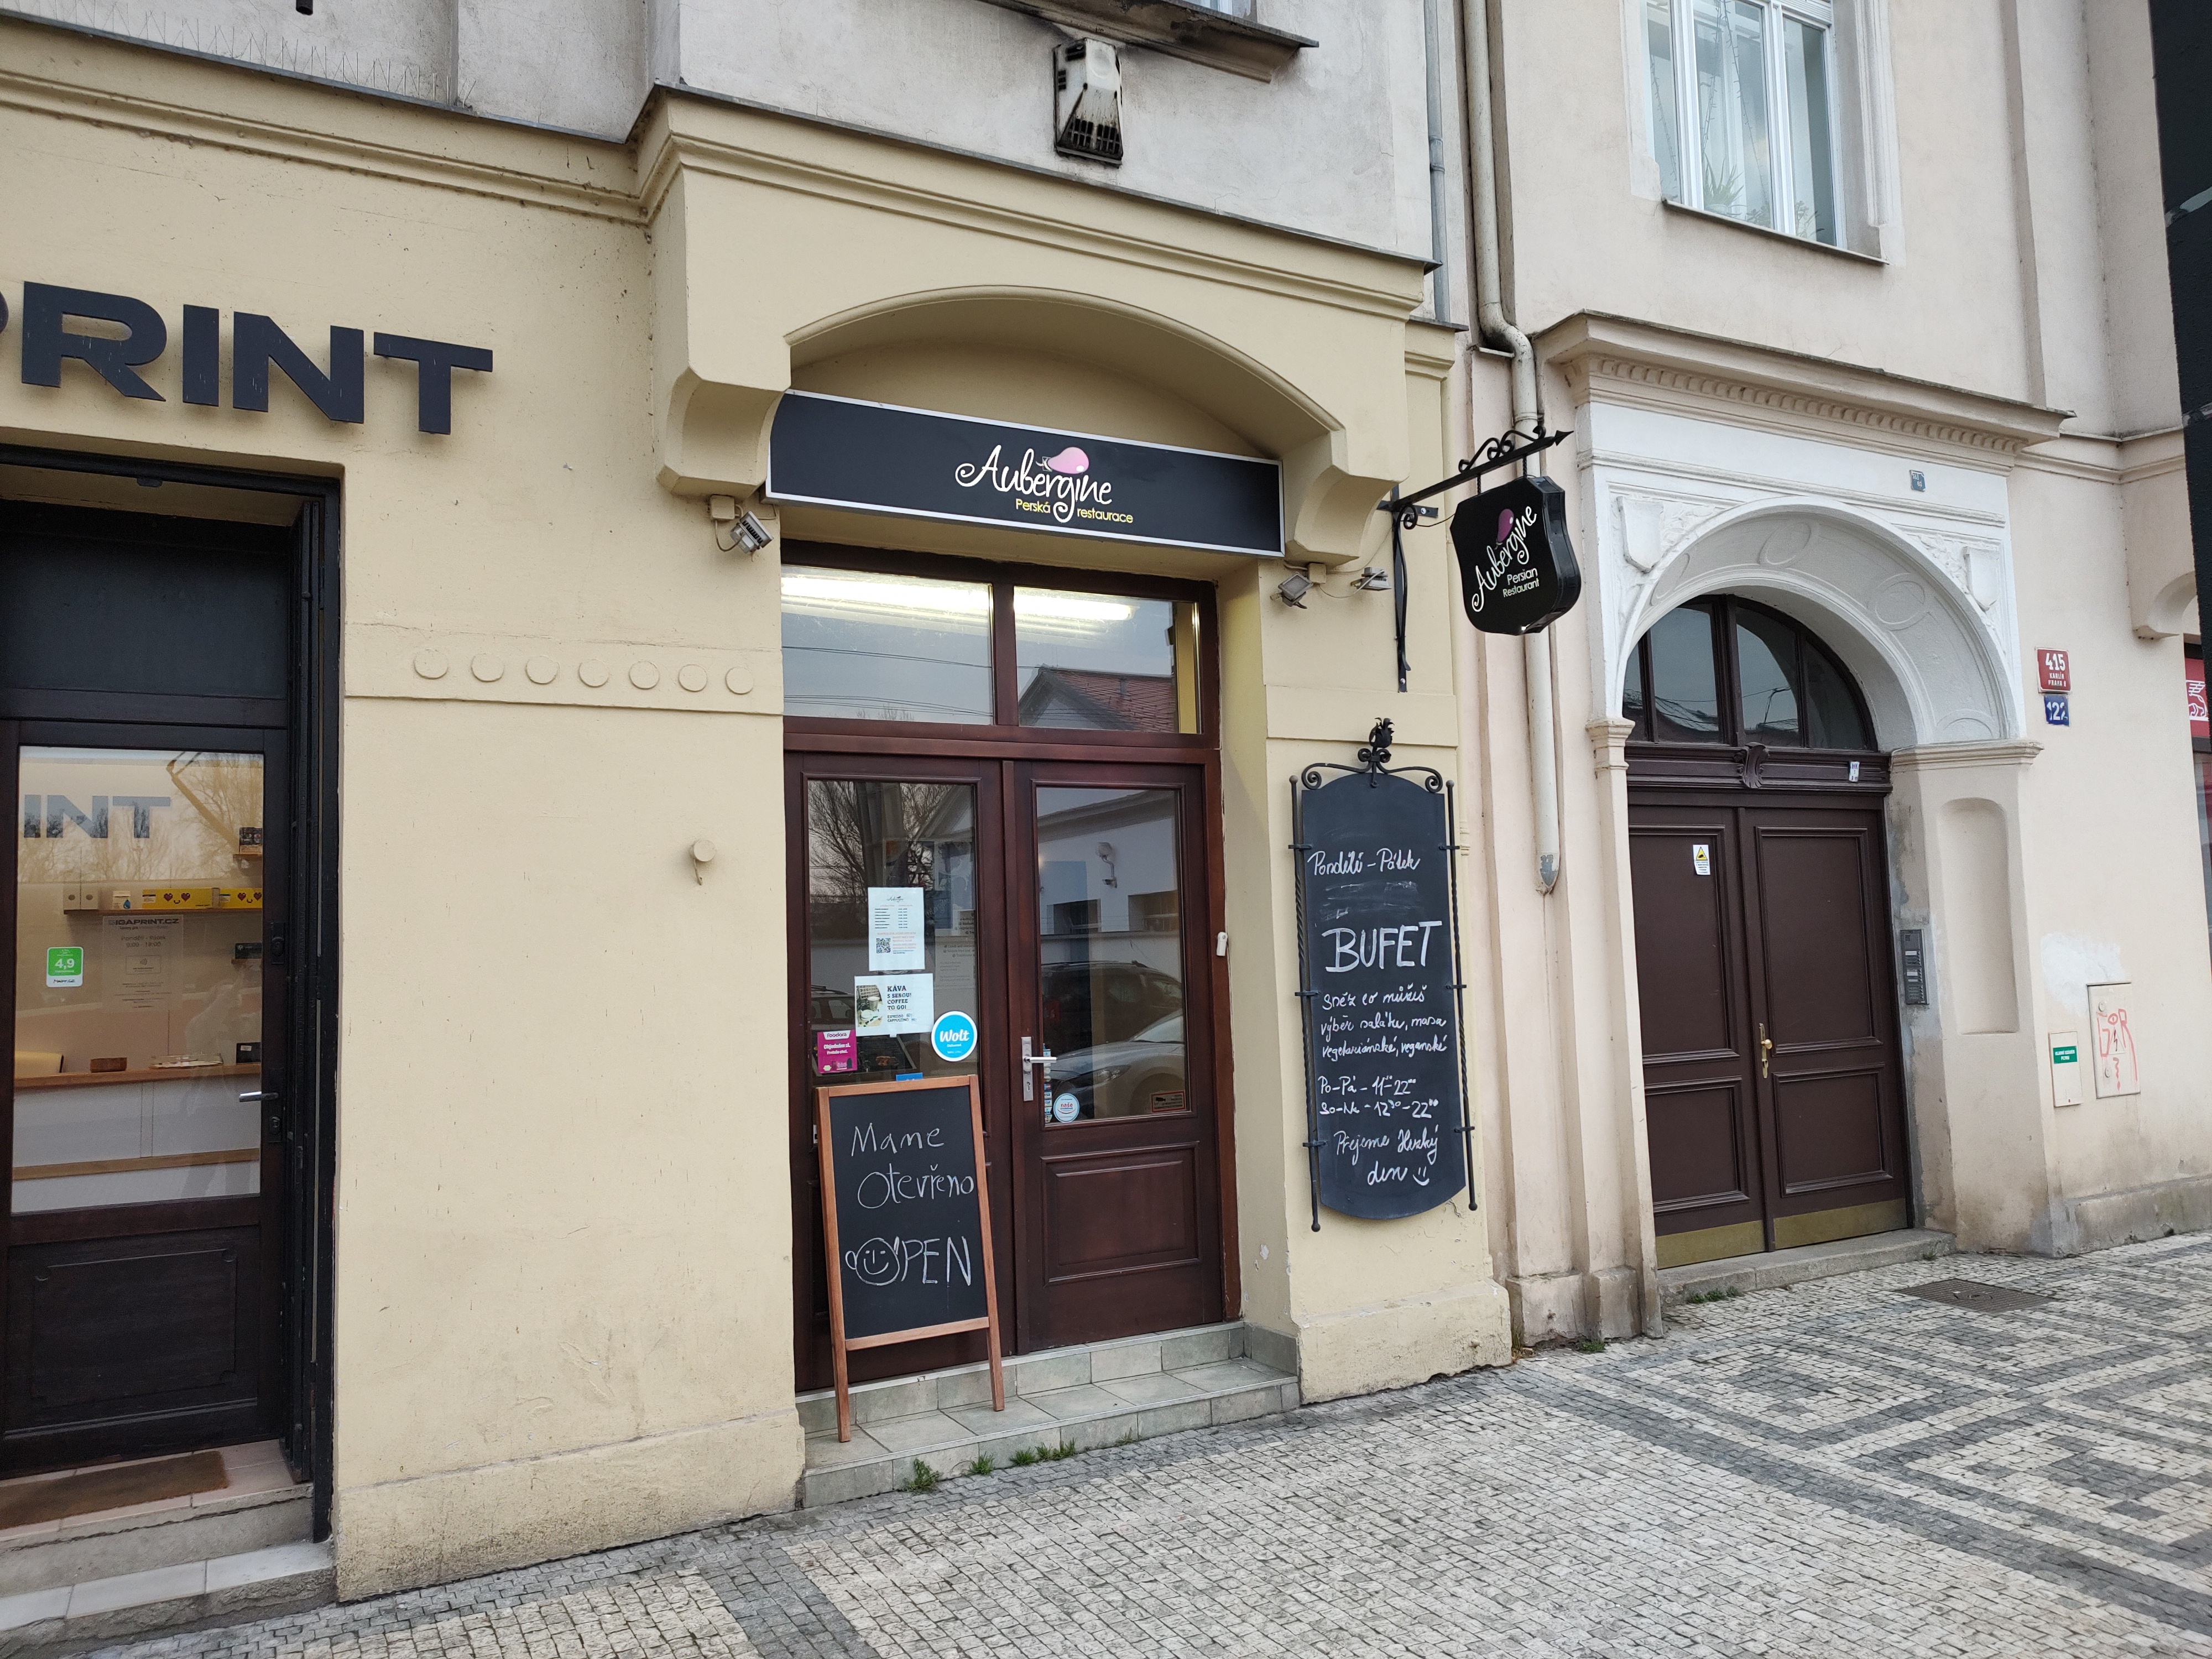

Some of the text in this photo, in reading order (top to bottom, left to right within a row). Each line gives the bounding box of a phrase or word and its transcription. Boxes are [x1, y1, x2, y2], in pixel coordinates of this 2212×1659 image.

[0, 281, 493, 435] RINT
[955, 445, 1112, 523] Aubergine
[1016, 498, 1134, 523] Perská restaurace
[1472, 505, 1537, 612] Aubergine
[1503, 578, 1540, 598] Restaurant
[1507, 567, 1538, 585] Persian
[2046, 653, 2066, 671] 415
[1322, 921, 1442, 972] BUFET
[55, 958, 75, 970] 4,9
[1362, 992, 1378, 1005] co
[940, 1029, 970, 1042] Wolt
[852, 1123, 944, 1156] Mame
[858, 1163, 974, 1209] Otevřeno
[1368, 1161, 1408, 1186] den
[846, 1236, 971, 1288] OPEN
